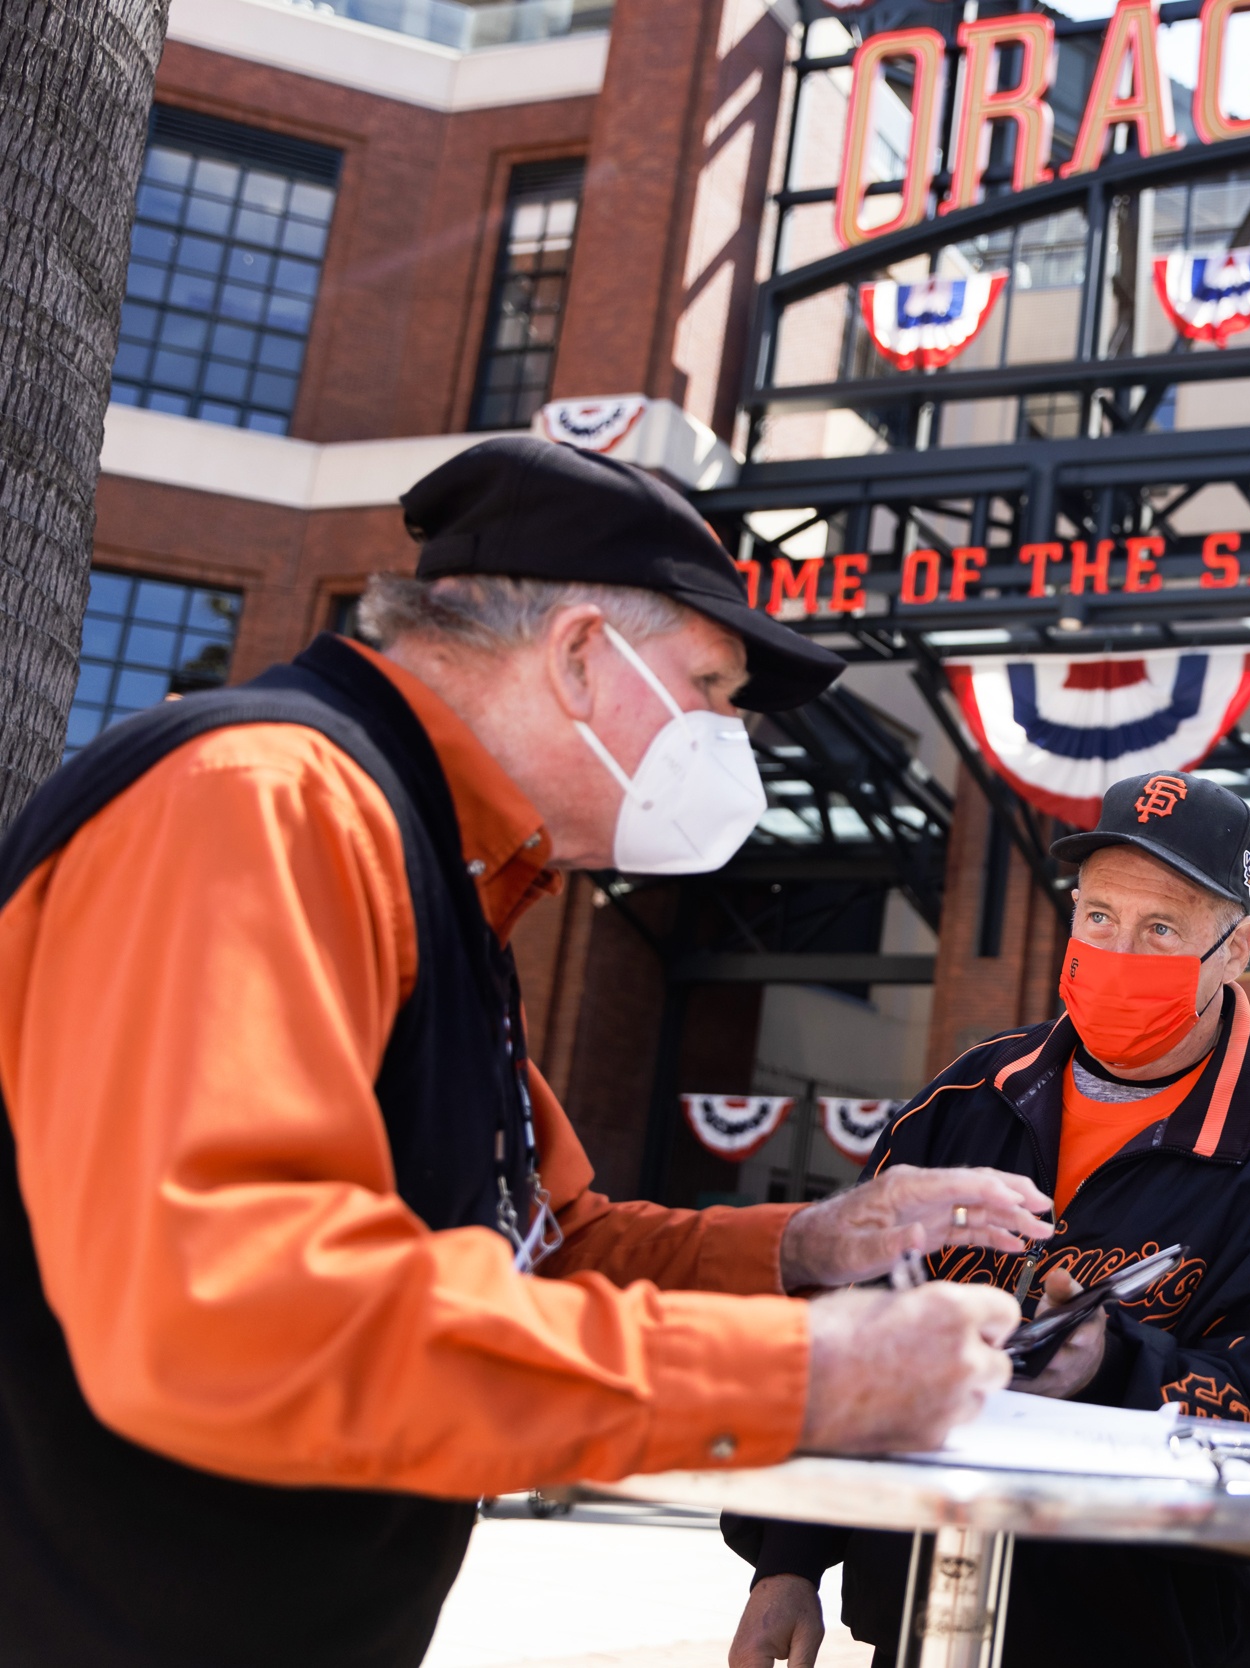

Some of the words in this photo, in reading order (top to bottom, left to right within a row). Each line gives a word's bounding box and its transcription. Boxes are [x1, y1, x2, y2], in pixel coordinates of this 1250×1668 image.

[901, 546, 988, 605] OF
[1019, 536, 1166, 598] THE
[1133, 774, 1188, 824] SF
